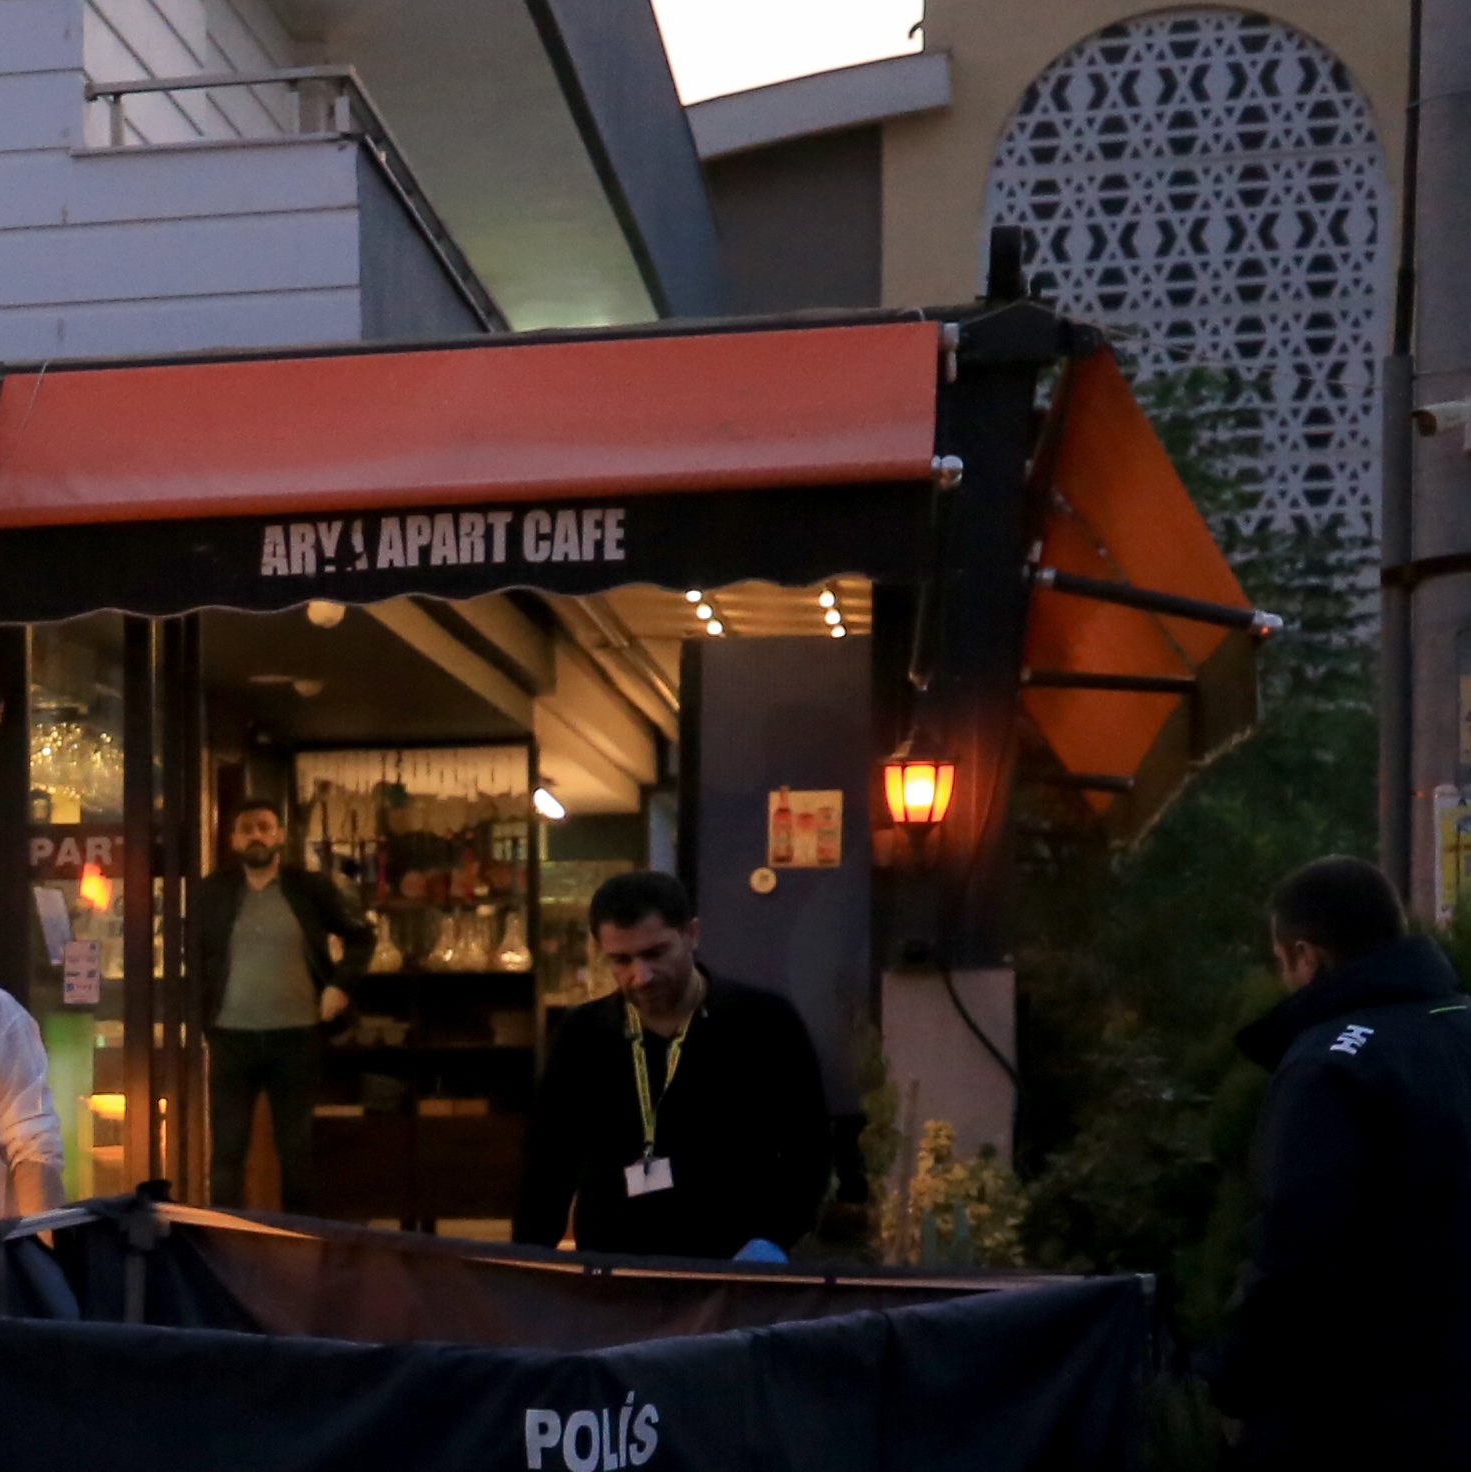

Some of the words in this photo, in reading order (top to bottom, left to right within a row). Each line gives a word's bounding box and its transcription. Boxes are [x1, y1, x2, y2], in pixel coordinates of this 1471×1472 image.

[376, 510, 513, 570] APART
[522, 507, 626, 564] CAFE
[30, 835, 124, 867] PAR
